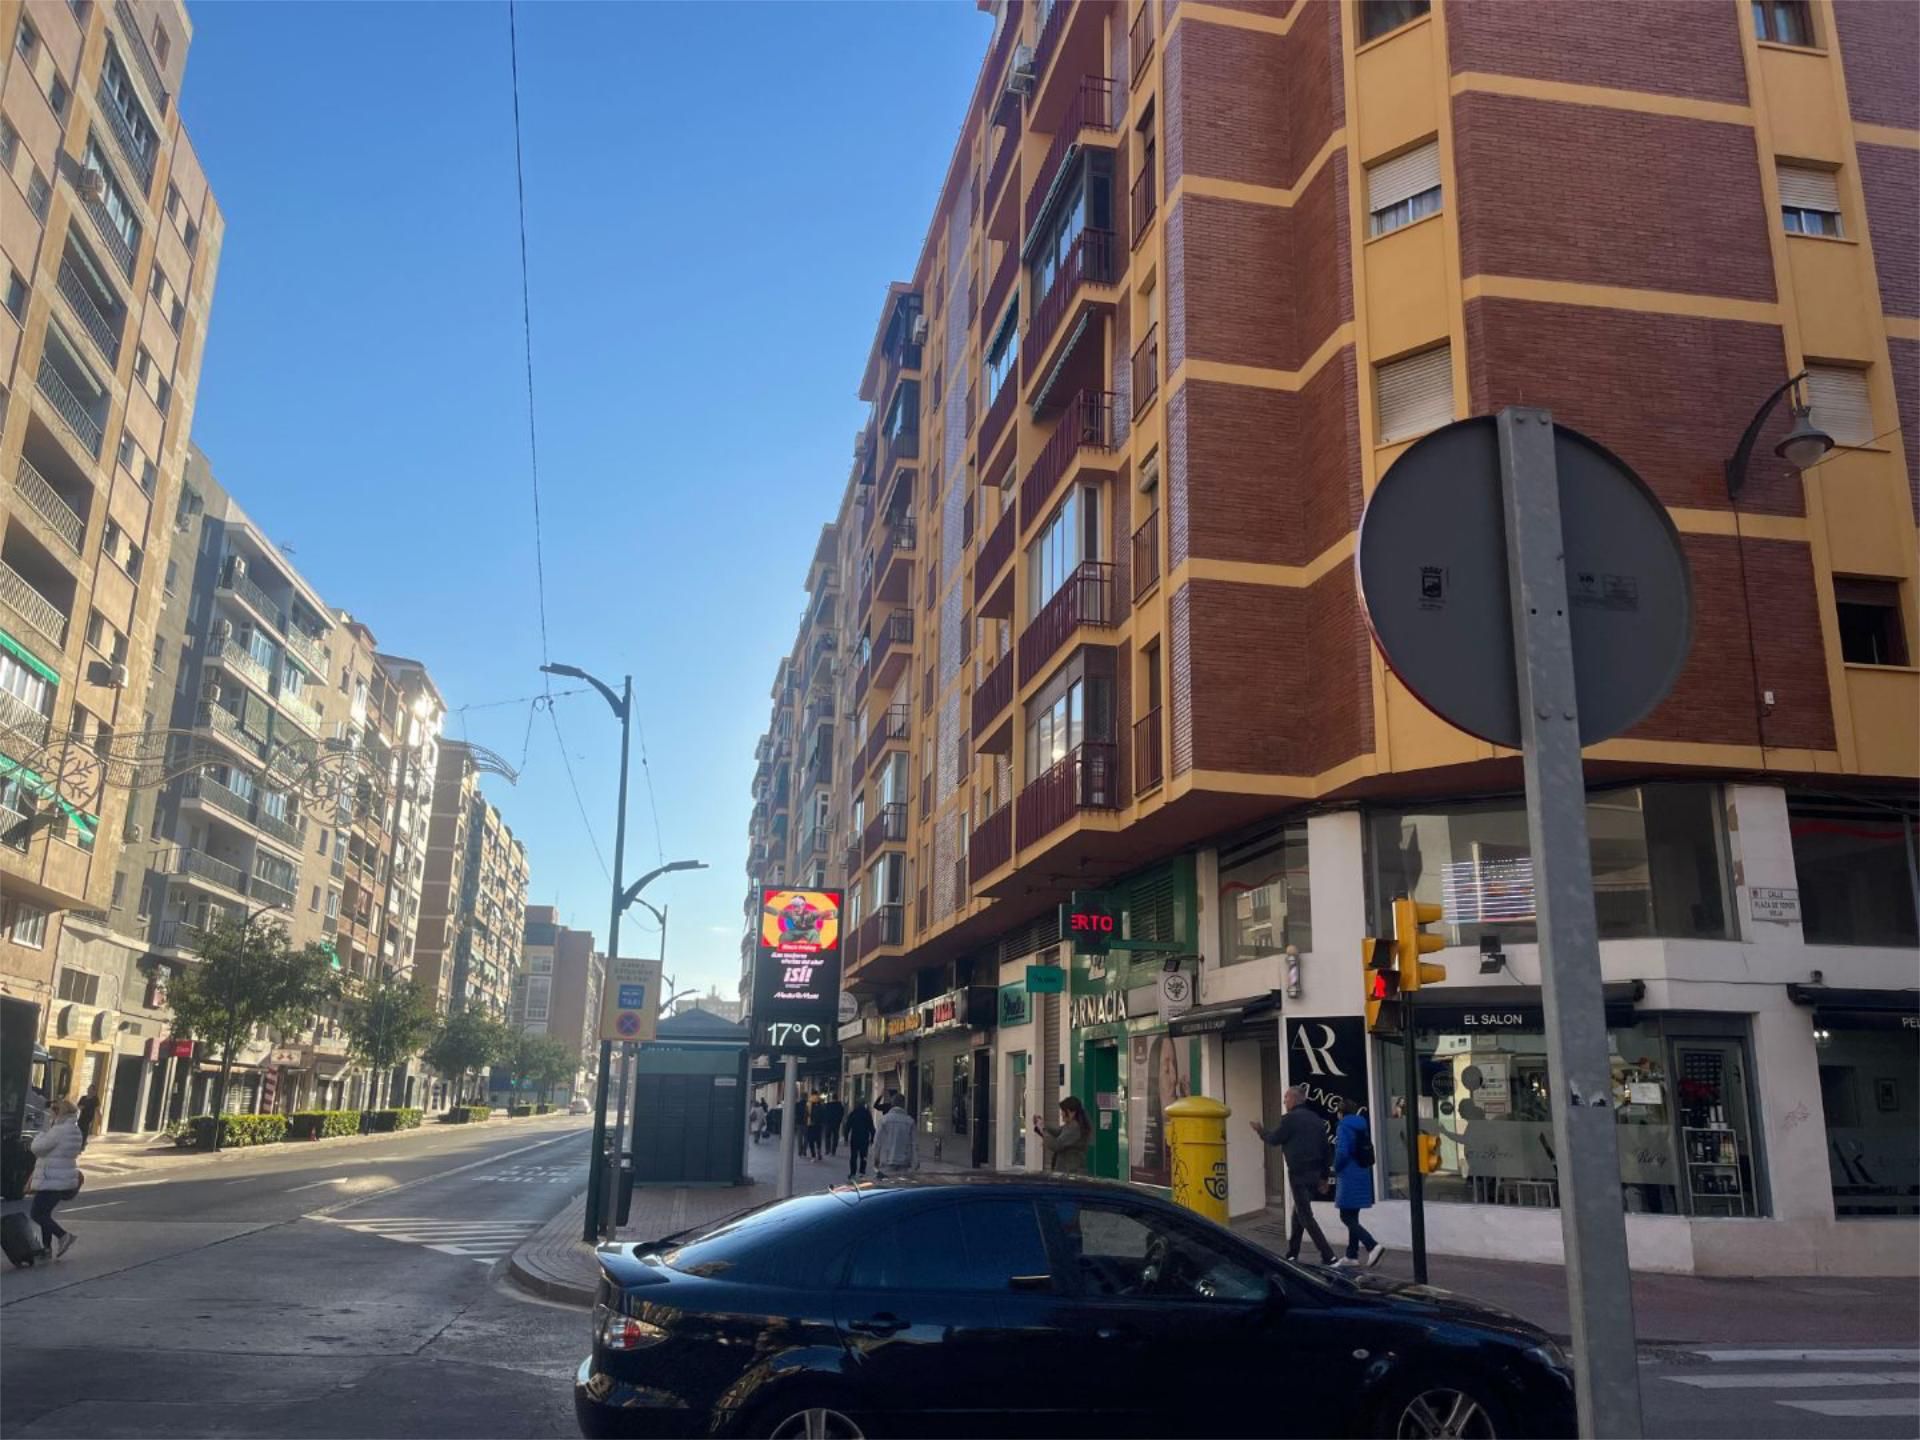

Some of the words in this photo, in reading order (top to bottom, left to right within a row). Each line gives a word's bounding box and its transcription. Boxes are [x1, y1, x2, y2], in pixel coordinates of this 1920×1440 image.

[1768, 890, 1784, 898] CALLE
[1463, 1014, 1479, 1025] EL
[1480, 1014, 1522, 1025] SALON
[767, 1021, 821, 1047] 17°C
[1291, 1023, 1348, 1077] AR
